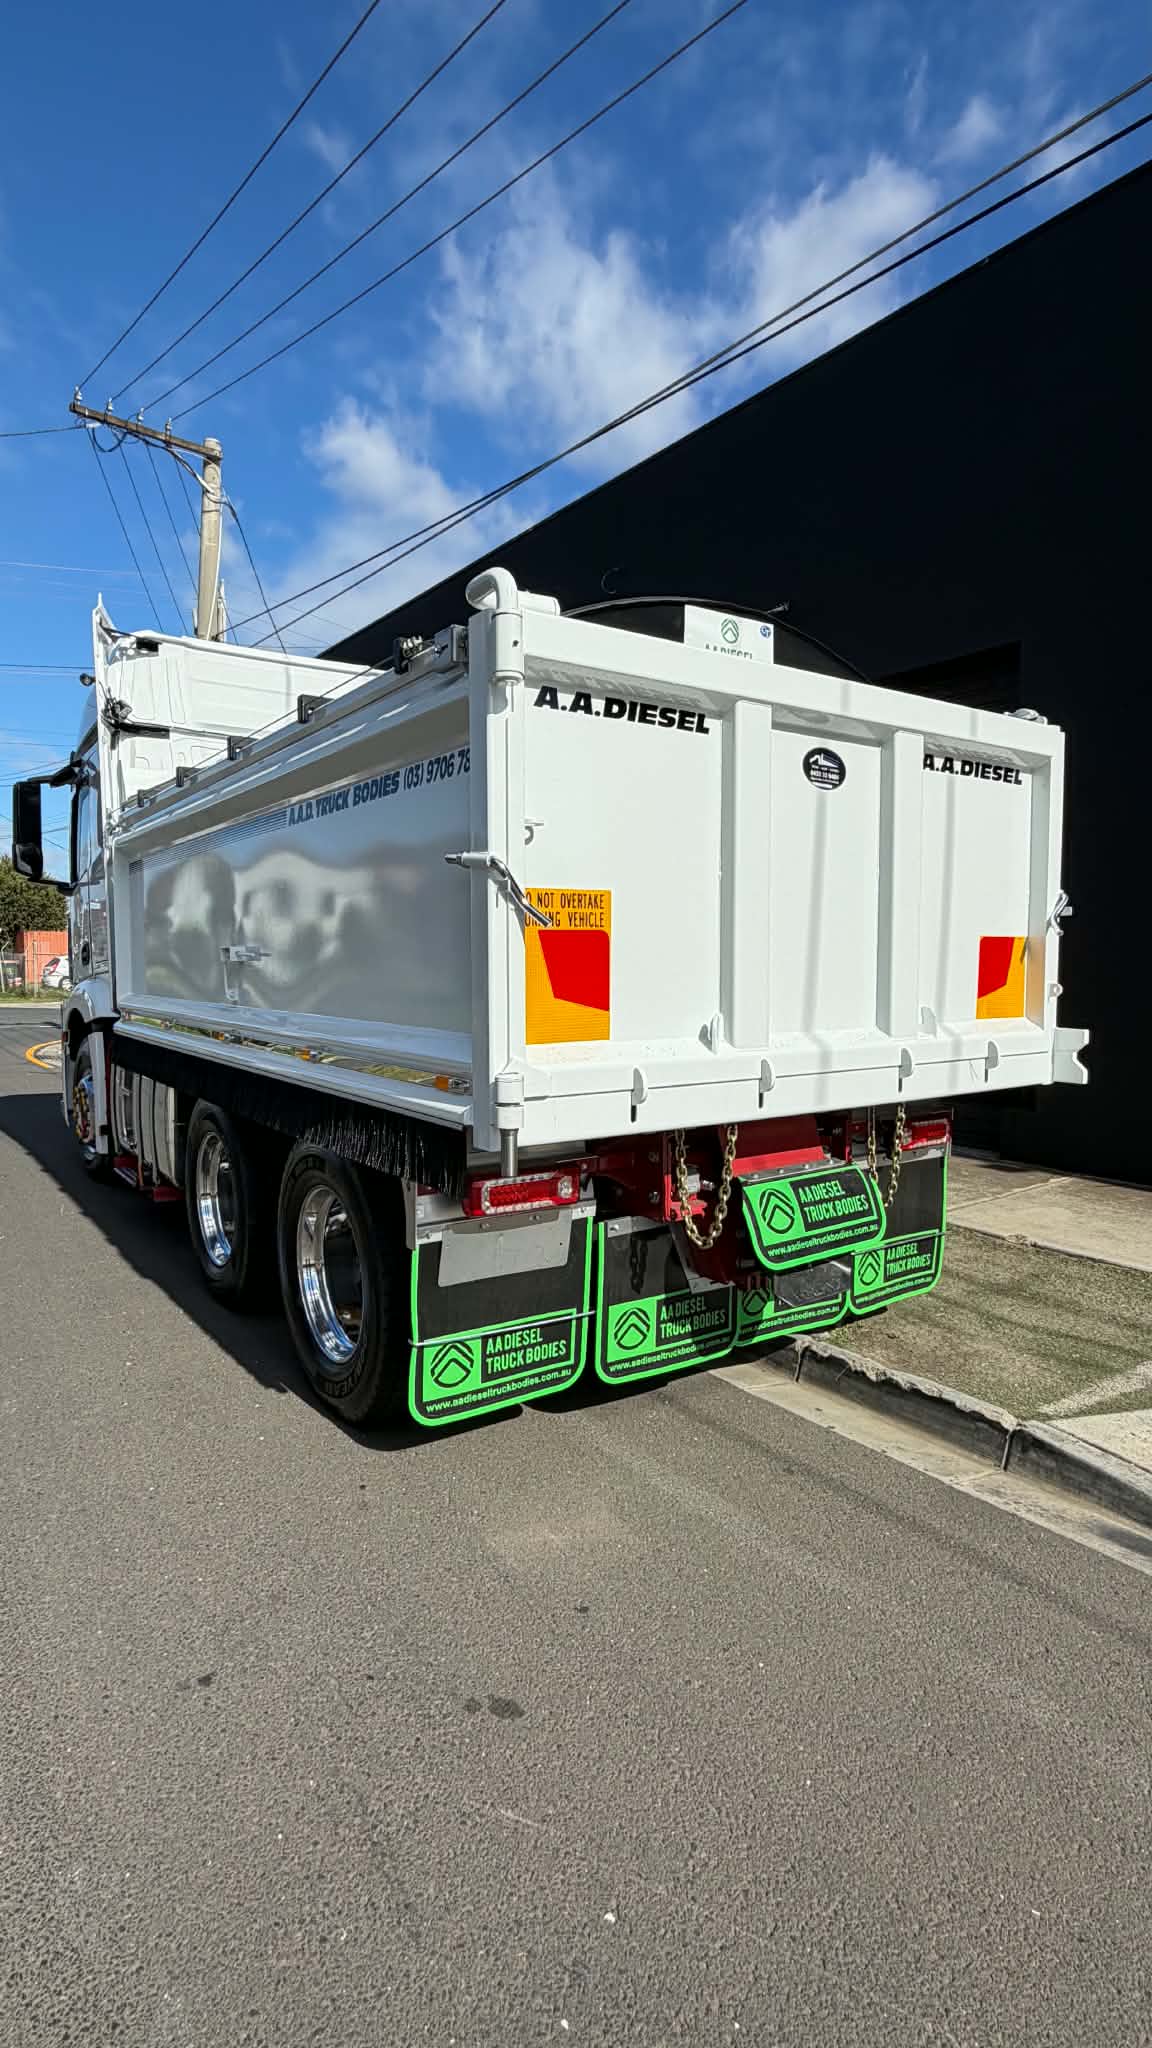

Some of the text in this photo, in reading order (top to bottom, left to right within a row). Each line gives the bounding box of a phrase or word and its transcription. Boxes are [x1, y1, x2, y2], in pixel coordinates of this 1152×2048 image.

[534, 685, 709, 734] A.A.DIESEL
[923, 753, 1022, 785] A.A.DIESEL
[315, 789, 351, 817] TRUCK
[353, 771, 400, 807] BODIES
[403, 762, 424, 790] (03)
[426, 753, 455, 783] 9706
[537, 892, 554, 908] NOT
[560, 893, 605, 909] OVERTAKE
[568, 912, 605, 927] VEHICLE
[814, 1180, 846, 1200] DIESEL
[804, 1194, 869, 1224] TRUCK BODIES
[767, 1224, 879, 1257] www.aadieseltruckbodies.com.au
[886, 1253, 931, 1277] TRUCK BODIES
[675, 1296, 706, 1317] DIESEL
[504, 1327, 543, 1350] DIESEL
[660, 1309, 726, 1339] TRUCK BODIES
[485, 1340, 567, 1375] TRUCK BODIES
[425, 1368, 572, 1413] www.aadieseltruckbodies.com.au
